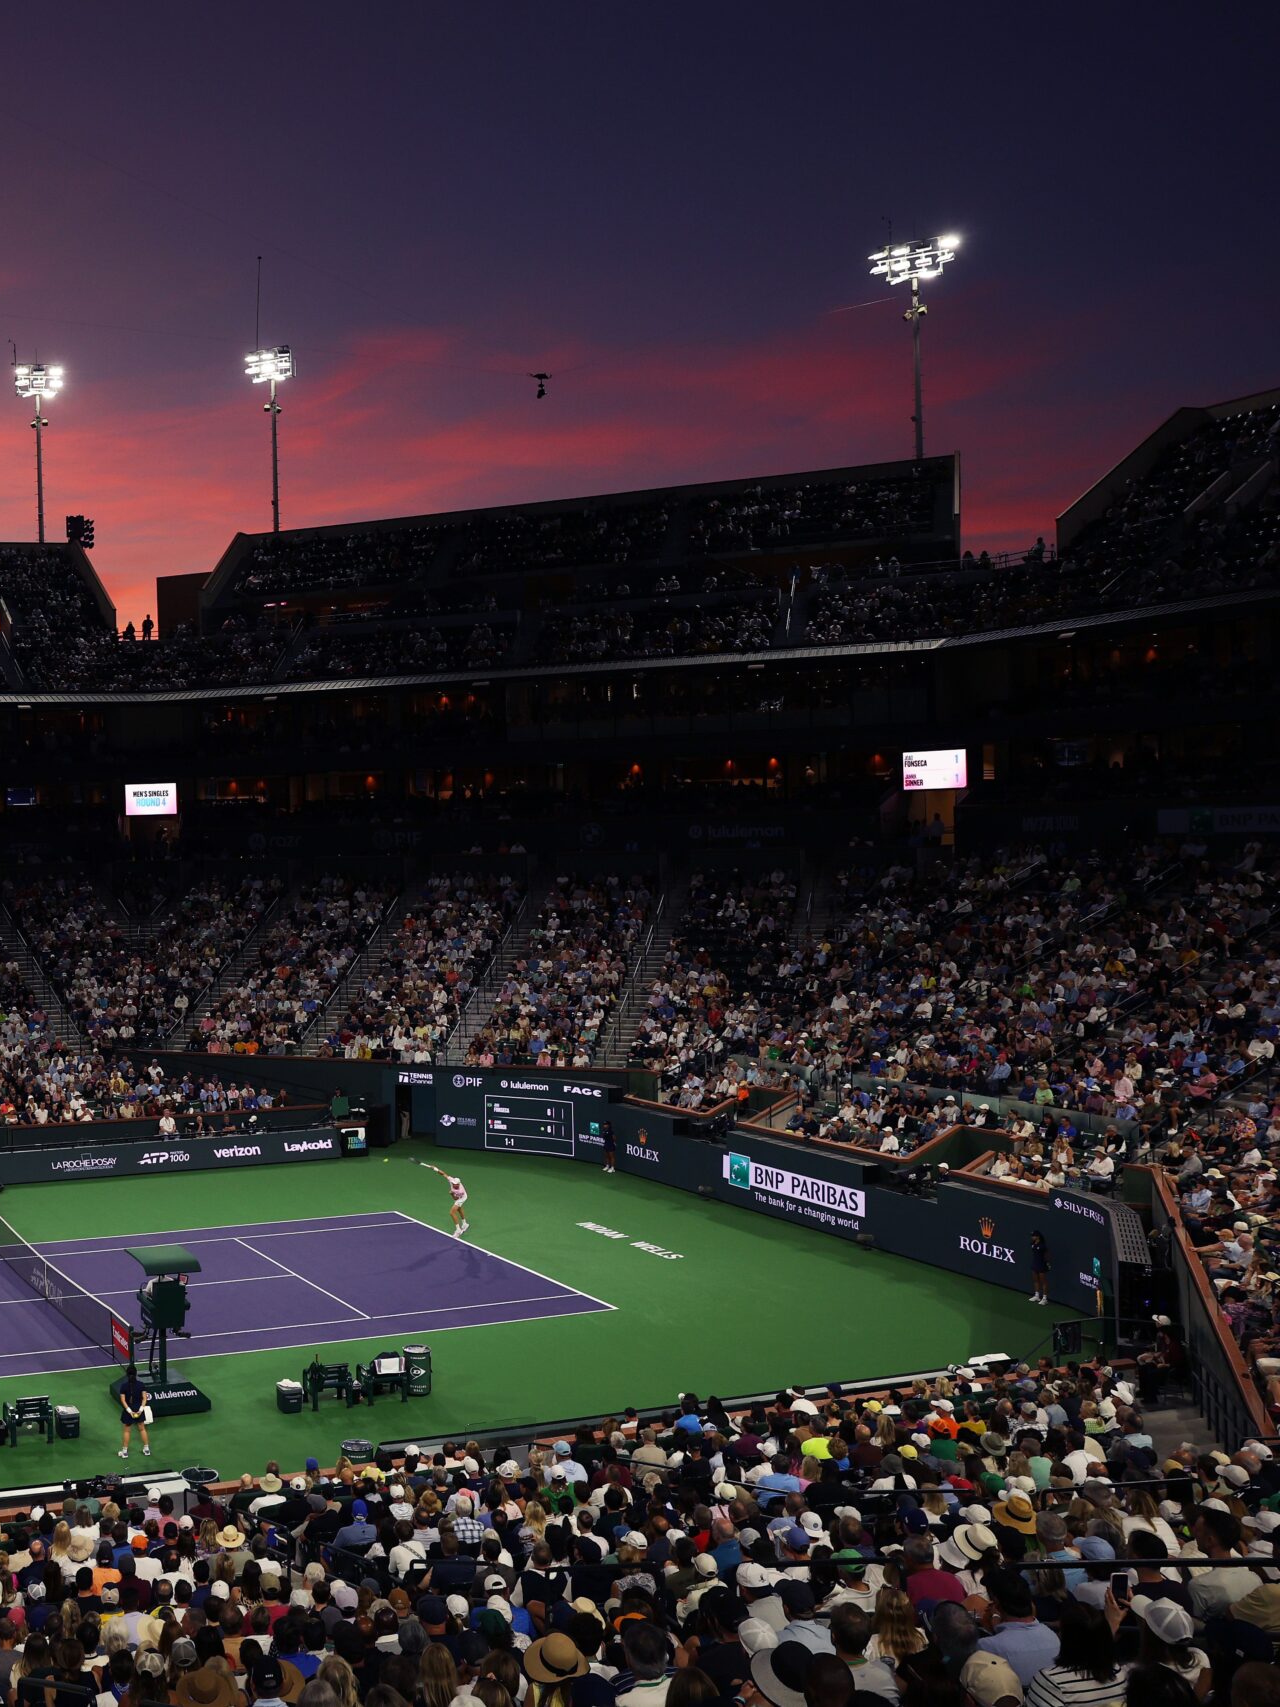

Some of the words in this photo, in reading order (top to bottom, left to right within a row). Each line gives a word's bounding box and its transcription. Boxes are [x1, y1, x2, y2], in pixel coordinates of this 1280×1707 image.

[136, 798, 160, 807] ROUND
[162, 798, 166, 806] 4
[708, 824, 785, 838] lululemon
[268, 834, 303, 847] razr
[394, 831, 423, 846] PIF
[409, 1072, 433, 1080] TENNIS
[466, 1077, 483, 1087] PIF
[510, 1080, 549, 1091] lululemon
[563, 1086, 602, 1098] FAGE
[214, 1144, 261, 1159] verizon
[283, 1138, 332, 1153] Laykold
[138, 1152, 169, 1165] ATP
[170, 1153, 190, 1162] 1000
[626, 1144, 659, 1162] ROLEX
[51, 1162, 63, 1170] LA
[63, 1159, 90, 1168] ROCHE
[91, 1157, 117, 1166] POSAY
[754, 1166, 784, 1190] BNP
[791, 1176, 859, 1212] PARIBAS
[754, 1191, 767, 1203] The
[768, 1194, 785, 1208] bank
[785, 1200, 797, 1213] for
[804, 1208, 836, 1226] changing
[837, 1216, 859, 1230] world
[1063, 1200, 1104, 1226] SILVERSEA
[629, 1241, 684, 1260] WELLS
[959, 1236, 1016, 1264] ROLEX
[112, 1325, 129, 1350] Emirates
[154, 1389, 197, 1400] lululemon
